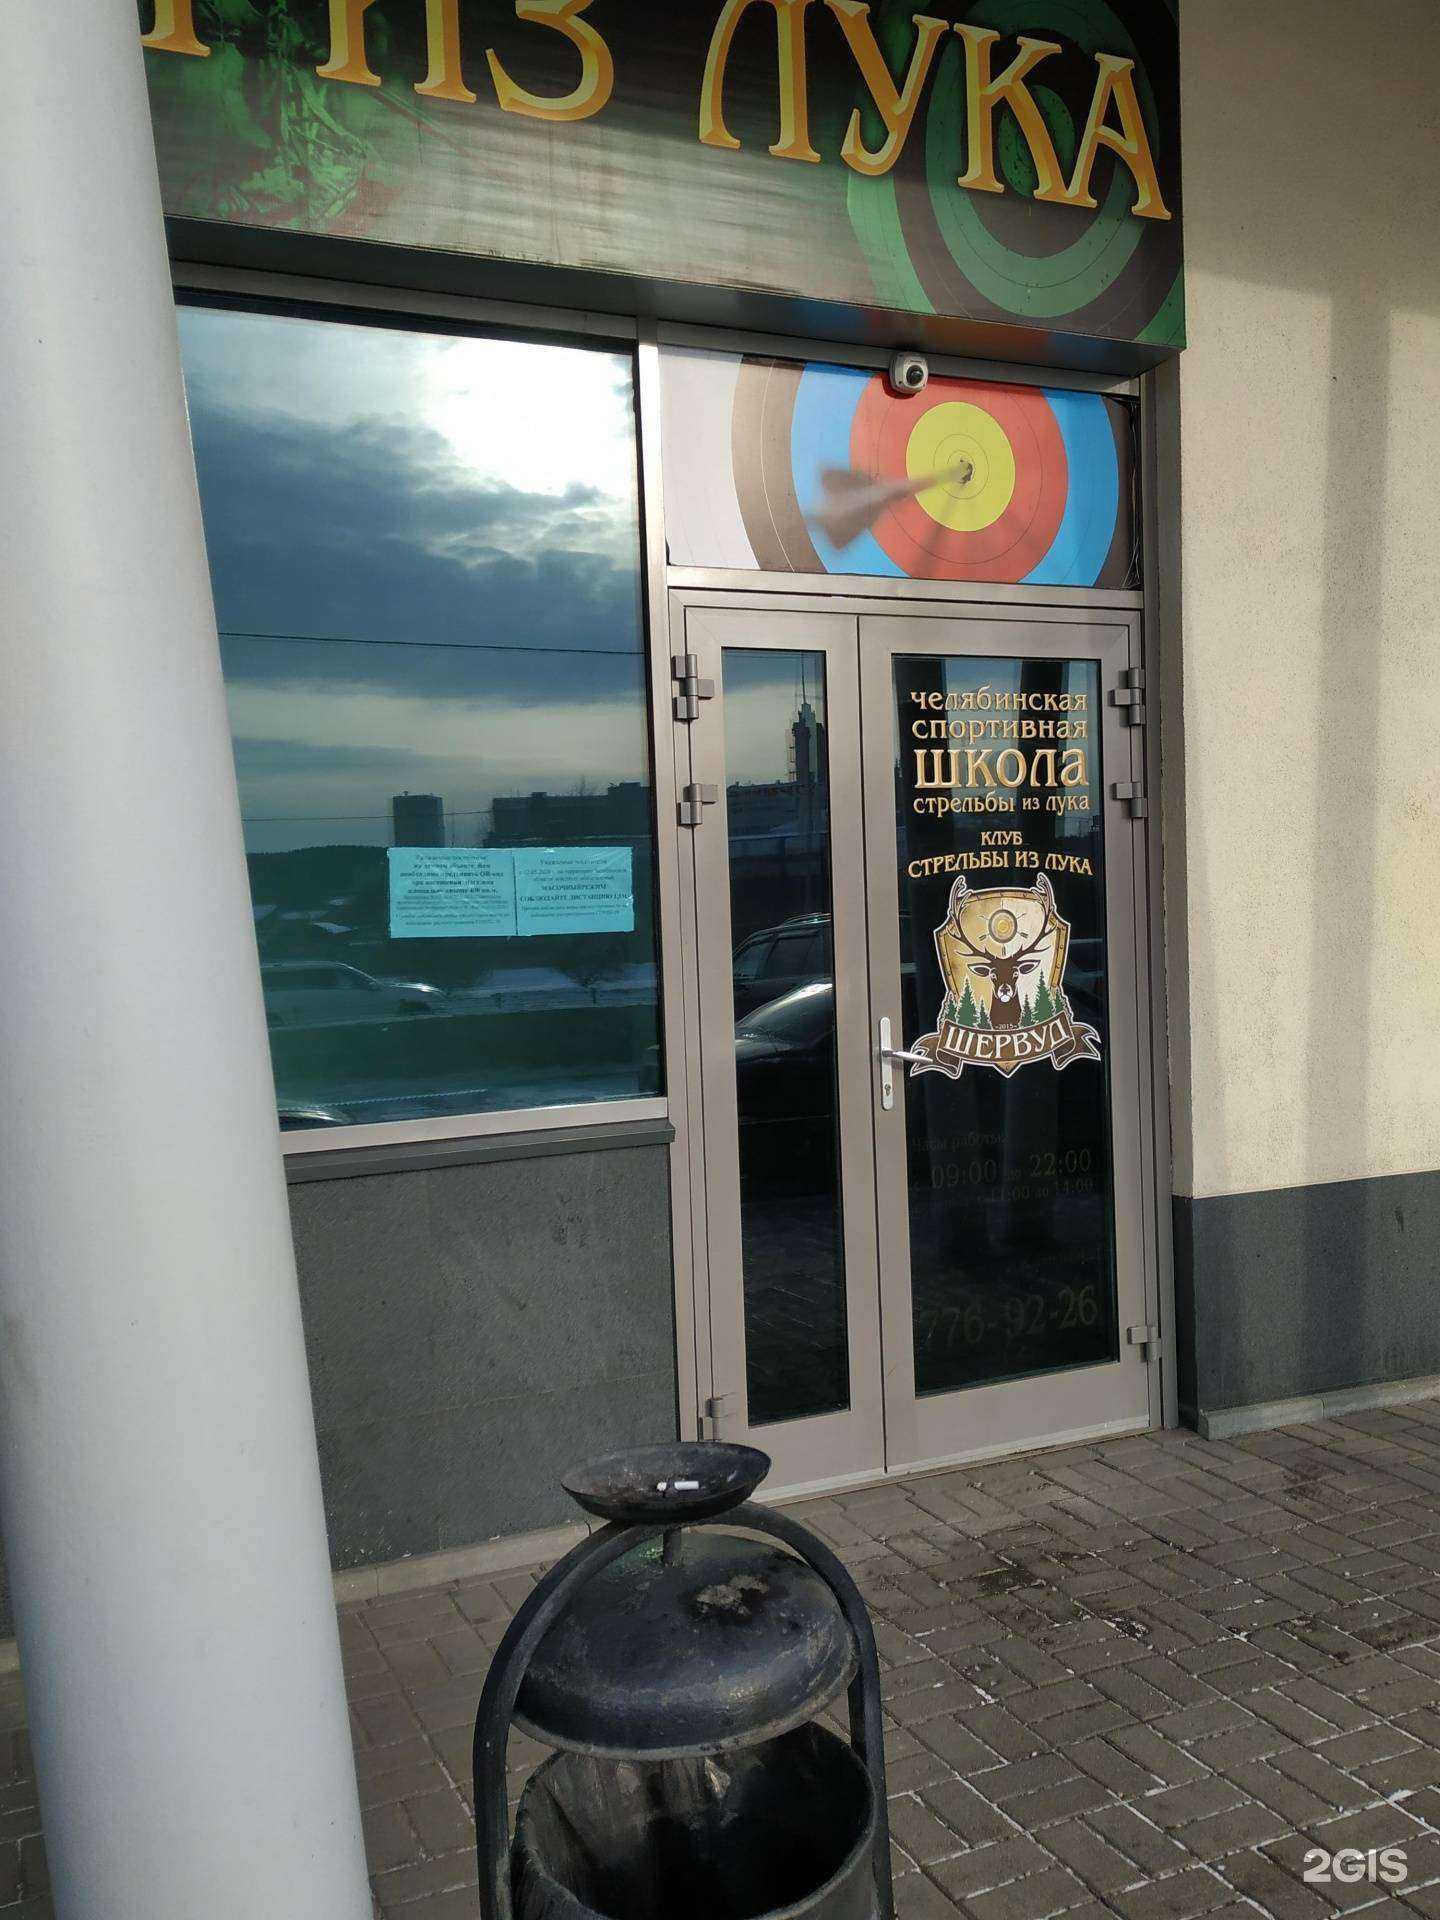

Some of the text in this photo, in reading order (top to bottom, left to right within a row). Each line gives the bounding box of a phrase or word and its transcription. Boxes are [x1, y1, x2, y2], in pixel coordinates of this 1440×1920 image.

[316, 0, 1173, 220] ИЗ ЛУКА
[911, 683, 1088, 711] челябинская
[911, 719, 1088, 744] спортивная
[913, 791, 1090, 817] стрельбы из лука
[980, 831, 1023, 846] КЛУБ
[908, 851, 1094, 878] СТРЕЛЬБЫ ИЗ ЛУКА
[943, 1018, 1070, 1059] ШЕРВУД
[931, 1160, 997, 1190] 09:00
[1029, 1148, 1092, 1177] 22:00
